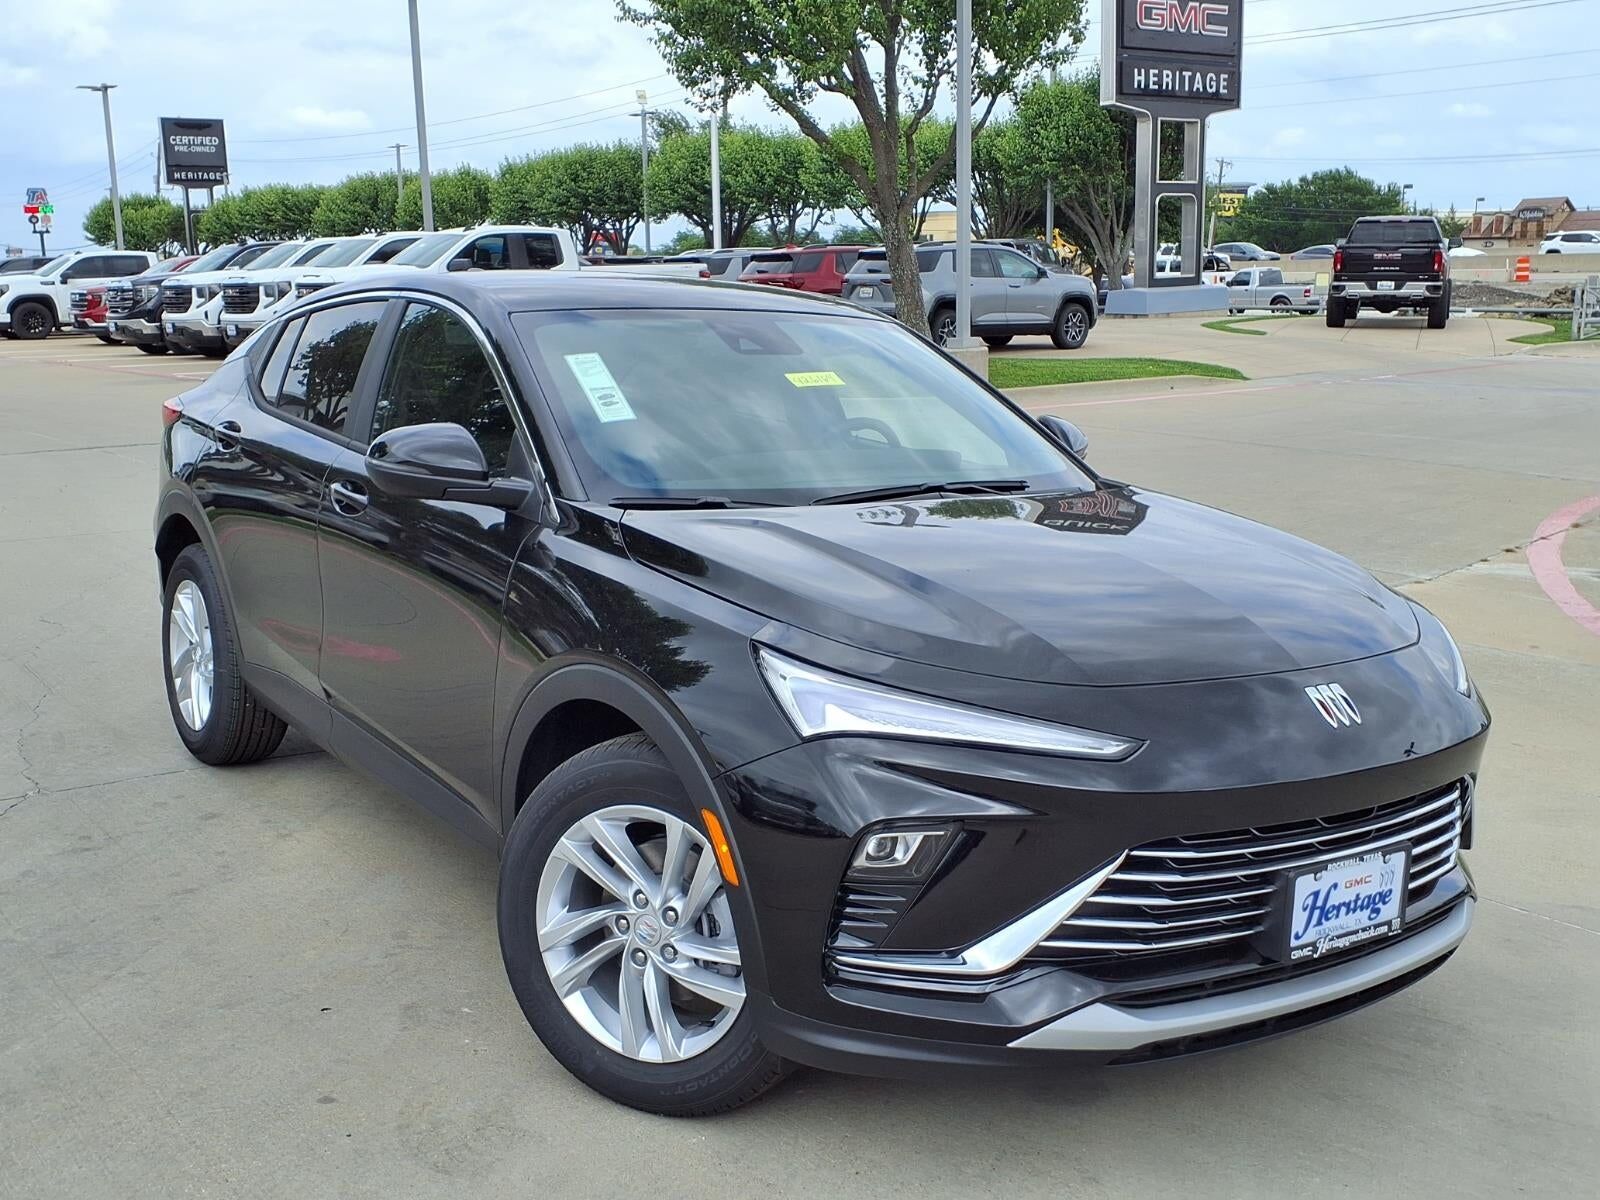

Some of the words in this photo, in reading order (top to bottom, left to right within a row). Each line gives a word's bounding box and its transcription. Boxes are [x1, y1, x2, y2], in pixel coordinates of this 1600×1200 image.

[1137, 0, 1228, 36] GMC
[1134, 68, 1228, 93] HERITAGE
[169, 135, 219, 146] CERTIFIED
[174, 145, 216, 153] PRE-OWNED
[173, 171, 222, 180] HERITAGE
[1344, 874, 1373, 889] GMC
[1294, 882, 1393, 940] Heritage
[1291, 947, 1313, 959] GMC
